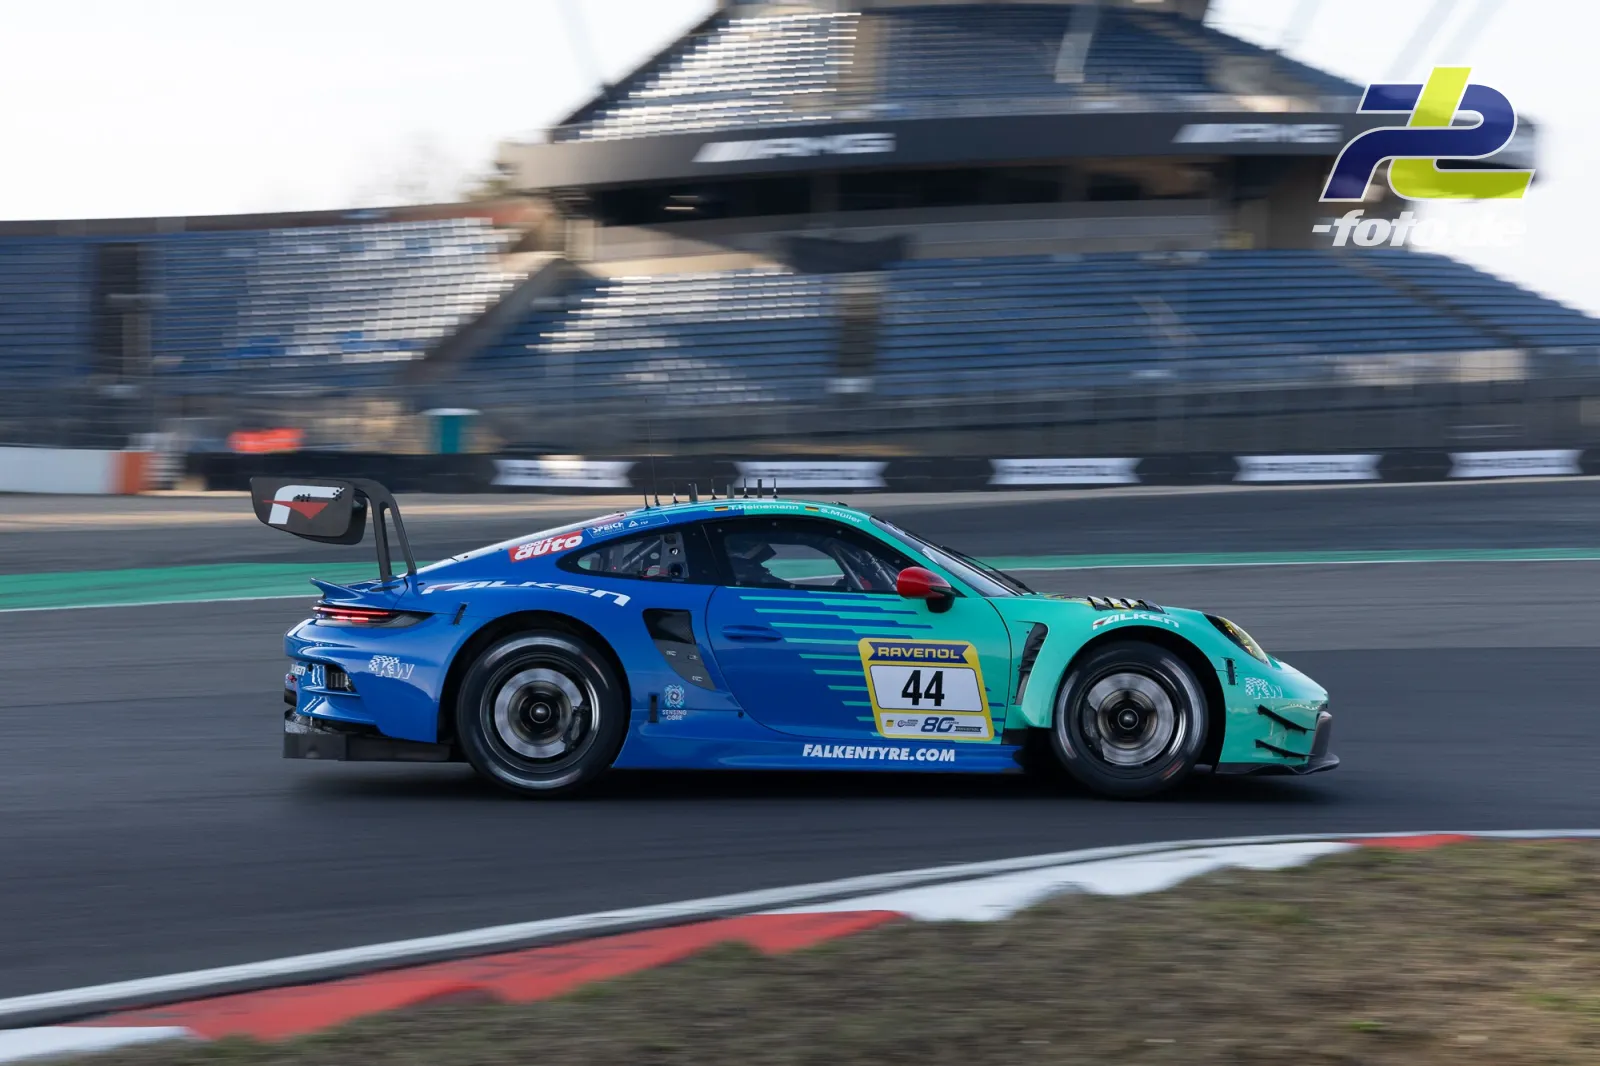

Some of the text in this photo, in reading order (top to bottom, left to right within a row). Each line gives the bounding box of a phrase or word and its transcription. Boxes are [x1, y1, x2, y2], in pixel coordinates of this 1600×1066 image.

[514, 535, 583, 560] auto
[421, 579, 631, 607] FALKEN
[1092, 612, 1180, 631] FALKEN
[877, 646, 960, 659] RAVENOL
[901, 669, 945, 707] 44
[920, 716, 955, 733] 80
[802, 743, 956, 762] FALKENTYRE.COM
